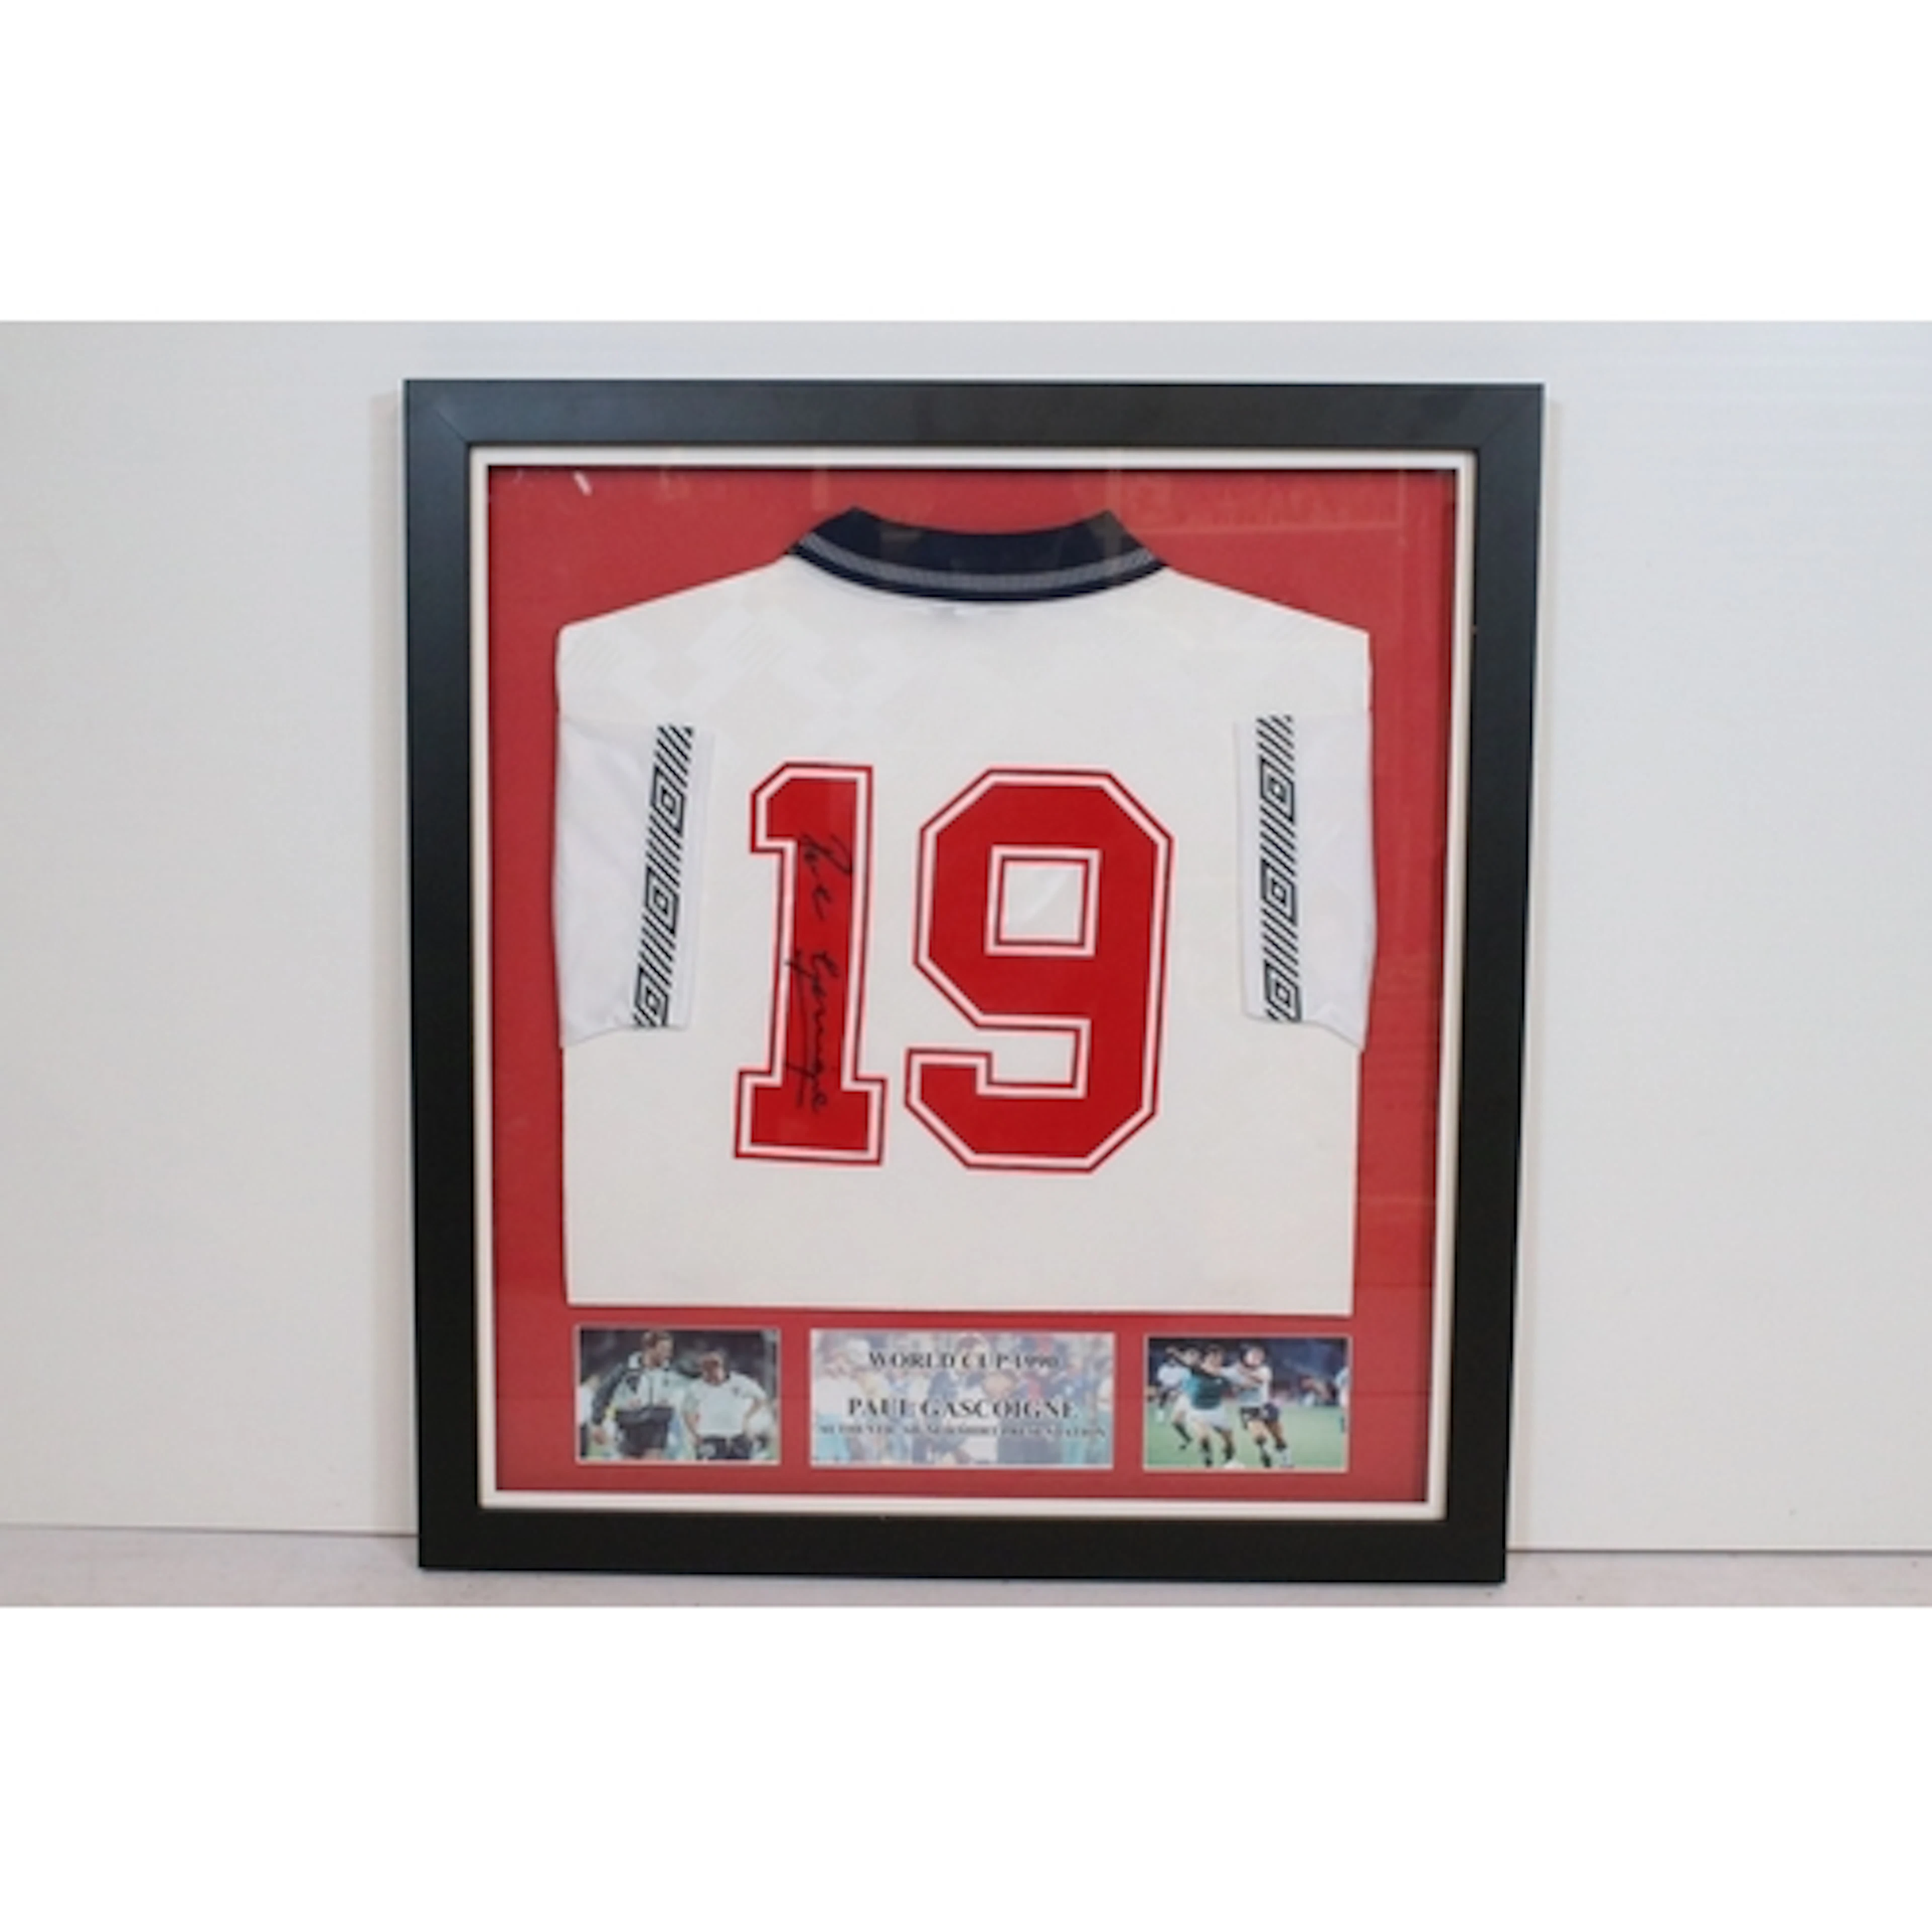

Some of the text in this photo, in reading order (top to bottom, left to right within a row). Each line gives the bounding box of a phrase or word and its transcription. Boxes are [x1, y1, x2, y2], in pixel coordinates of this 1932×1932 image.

[734, 761, 1175, 1174] 19
[868, 1351, 955, 1369] WORLD
[961, 1352, 1010, 1370] CUP
[848, 1398, 1080, 1419] PAUL GASCOIGNE
